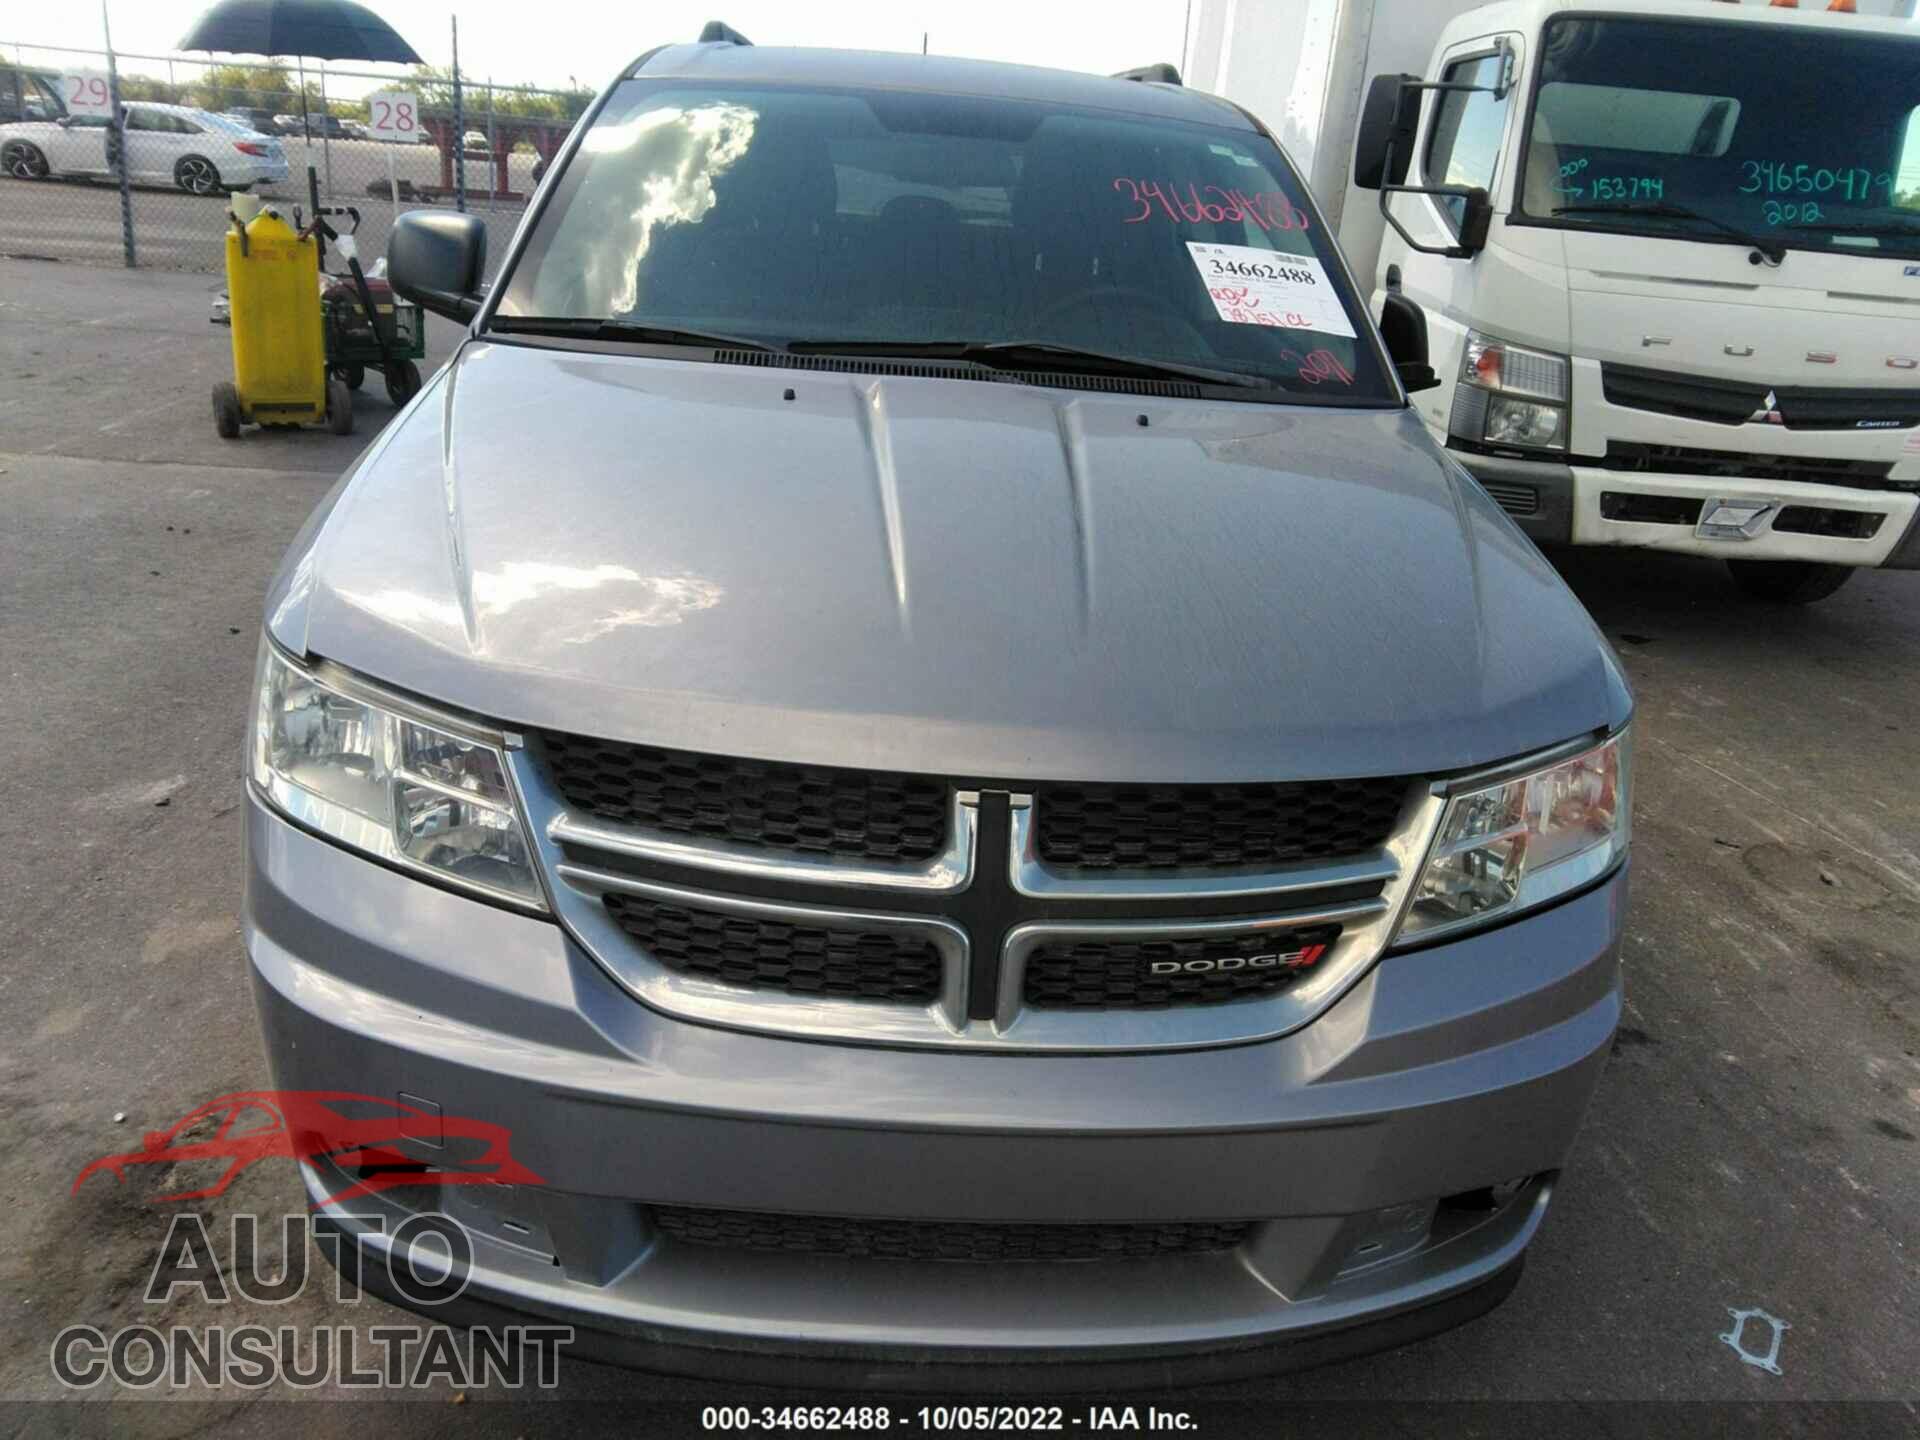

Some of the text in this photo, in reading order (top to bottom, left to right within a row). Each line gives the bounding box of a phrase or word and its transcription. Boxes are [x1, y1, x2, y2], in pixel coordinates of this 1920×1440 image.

[68, 76, 108, 106] 29
[375, 101, 414, 132] 28
[1592, 177, 1664, 199] 153794
[1738, 160, 1893, 200] 34650479
[1762, 200, 1825, 225] 2012
[1210, 259, 1316, 286] 34662488
[1642, 335, 1919, 370] FUSO
[1151, 950, 1305, 974] DODGE
